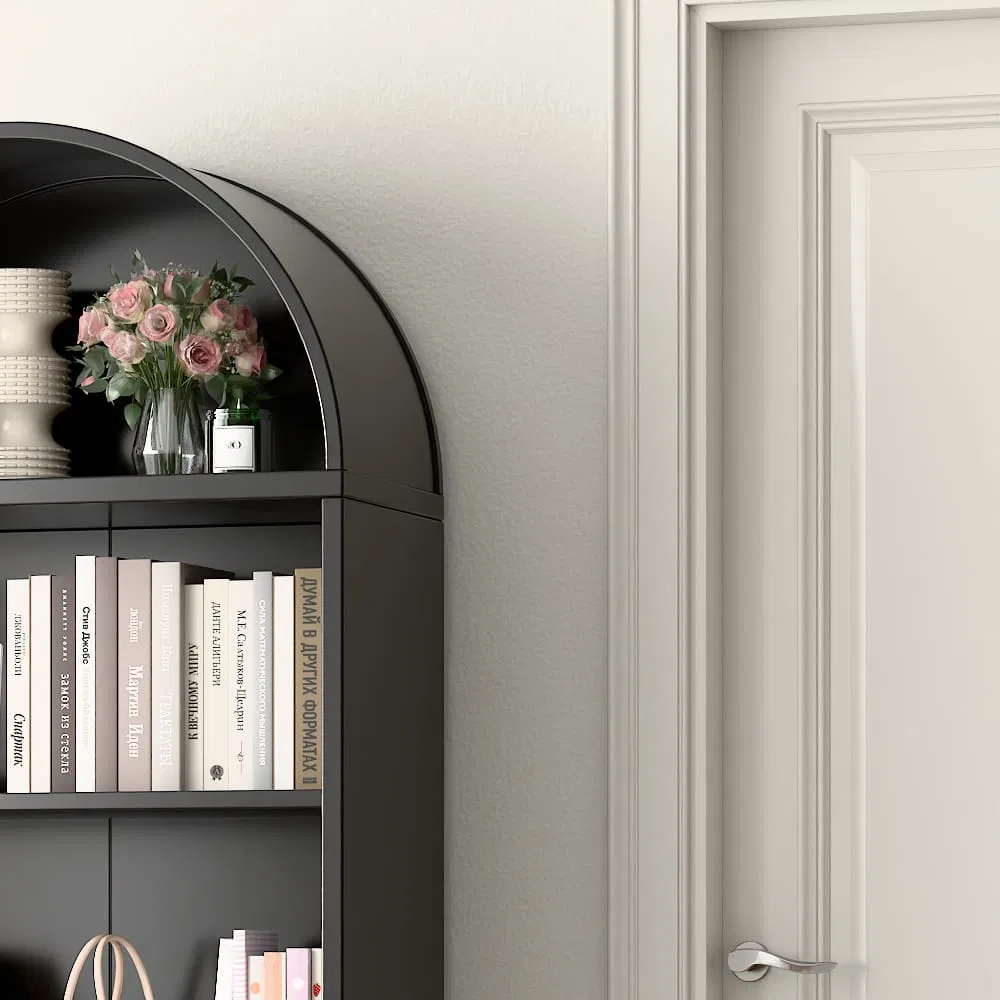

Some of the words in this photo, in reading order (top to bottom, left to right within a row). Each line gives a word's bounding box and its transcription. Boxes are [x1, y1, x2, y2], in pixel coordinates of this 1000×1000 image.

[82, 606, 91, 630] Стив
[210, 601, 221, 635] ДАНТЕ
[300, 576, 321, 625] ДУМАЙ
[81, 632, 91, 665] Джобс
[302, 629, 317, 638] В
[187, 642, 199, 677] МИРУ
[212, 636, 221, 687] АЛИГЬЕРИ
[300, 642, 317, 696] ДРУГИХ
[125, 665, 144, 719] Мартин
[12, 713, 26, 768] Спартак
[127, 723, 144, 759] Иден
[302, 699, 317, 773] ФОРМАТАХ
